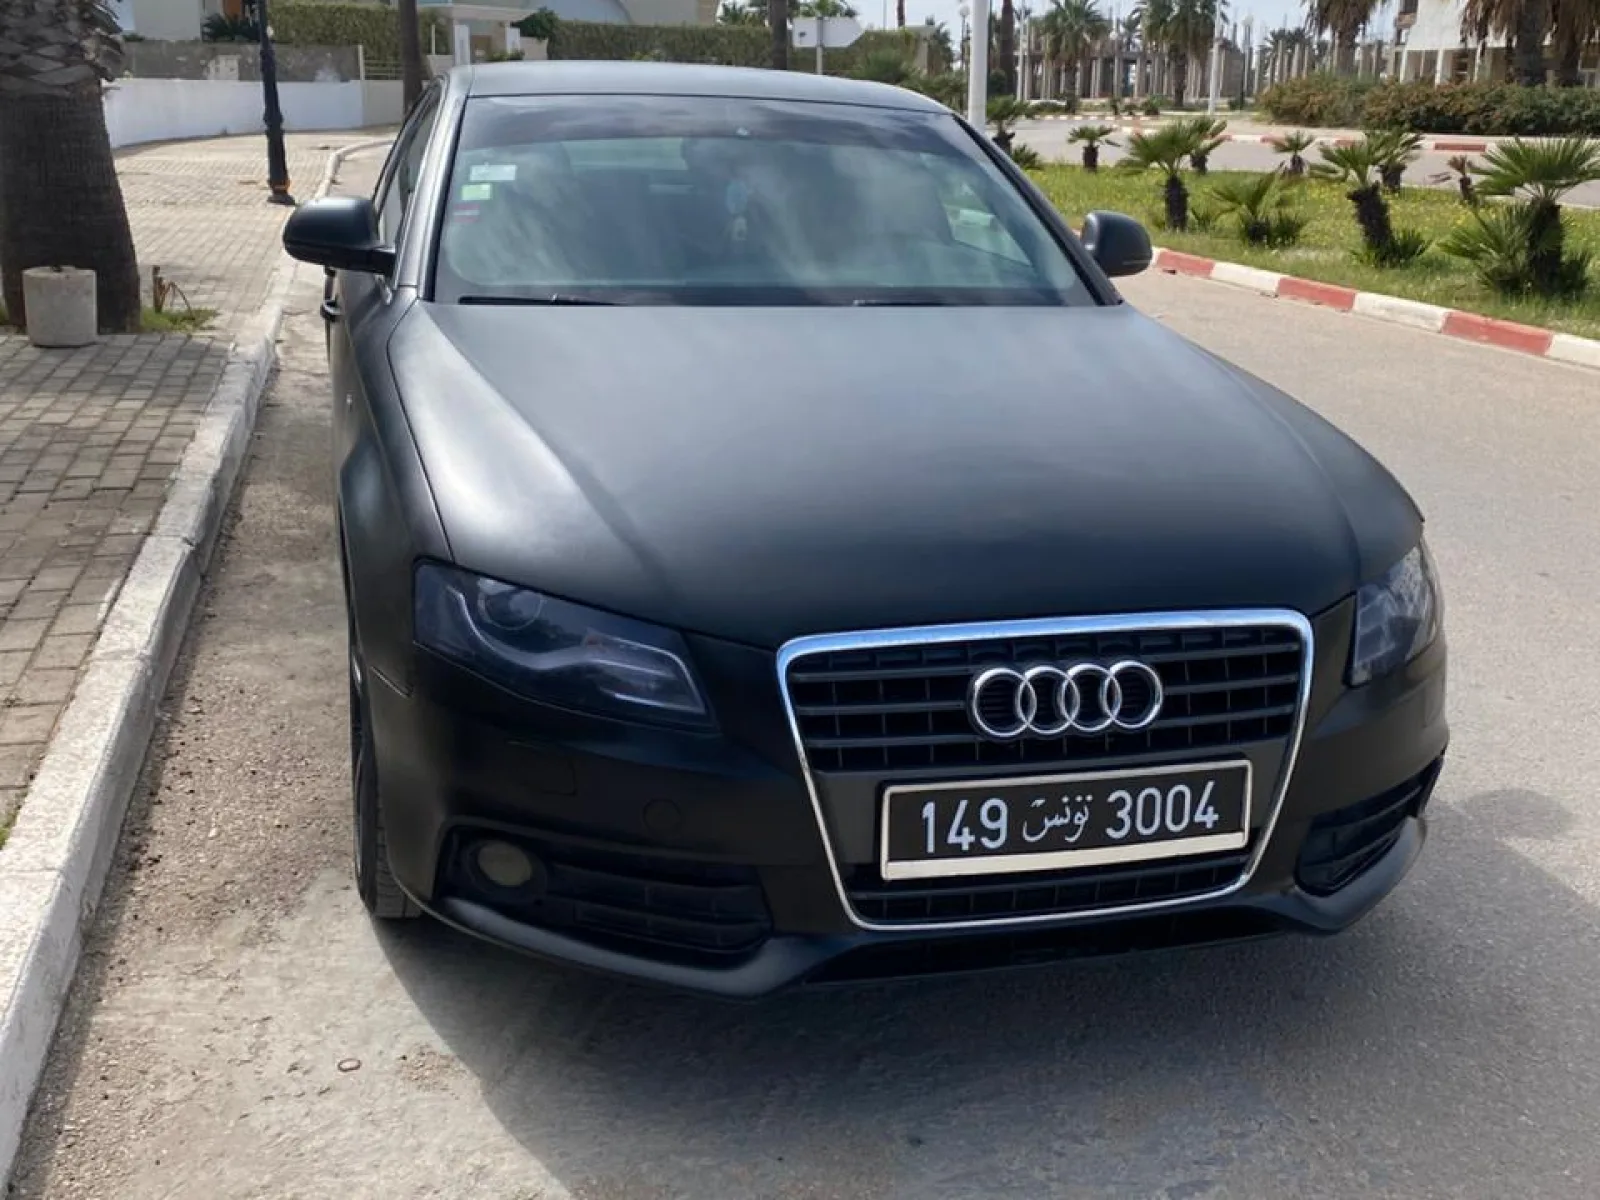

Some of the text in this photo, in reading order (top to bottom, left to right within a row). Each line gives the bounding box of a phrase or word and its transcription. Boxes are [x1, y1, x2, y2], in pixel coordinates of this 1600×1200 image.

[921, 780, 1219, 854] 149 تونس 3004
